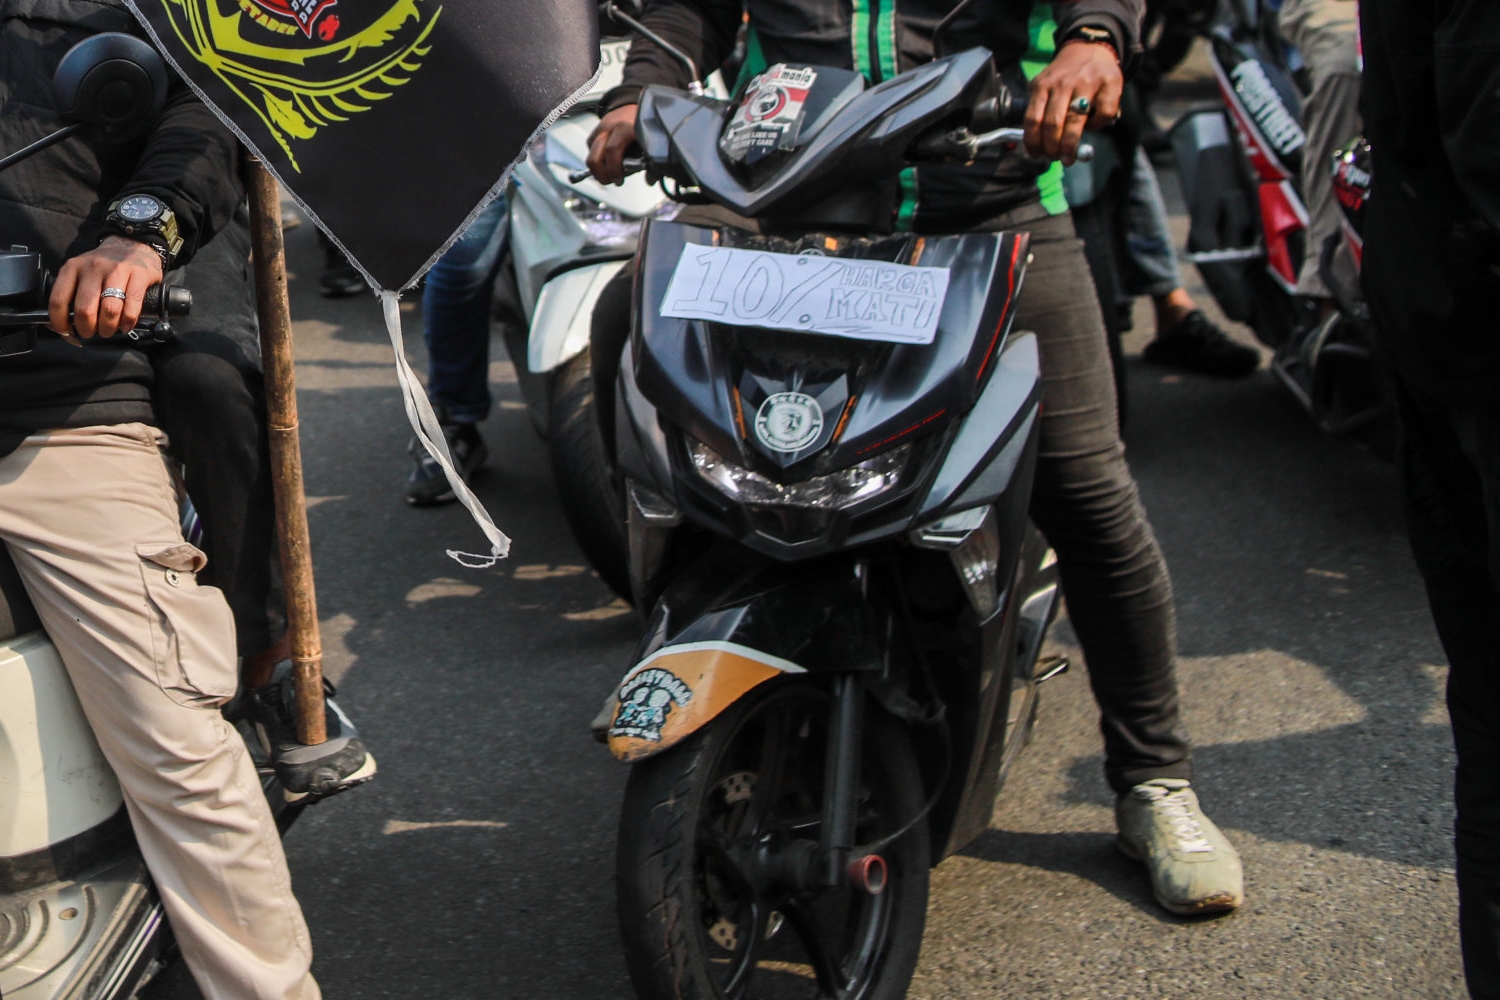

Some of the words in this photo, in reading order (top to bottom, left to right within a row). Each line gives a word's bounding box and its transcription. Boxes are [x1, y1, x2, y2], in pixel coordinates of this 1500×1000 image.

[672, 248, 843, 324] 10%
[838, 263, 938, 298] HARGA
[825, 287, 938, 329] MATI
